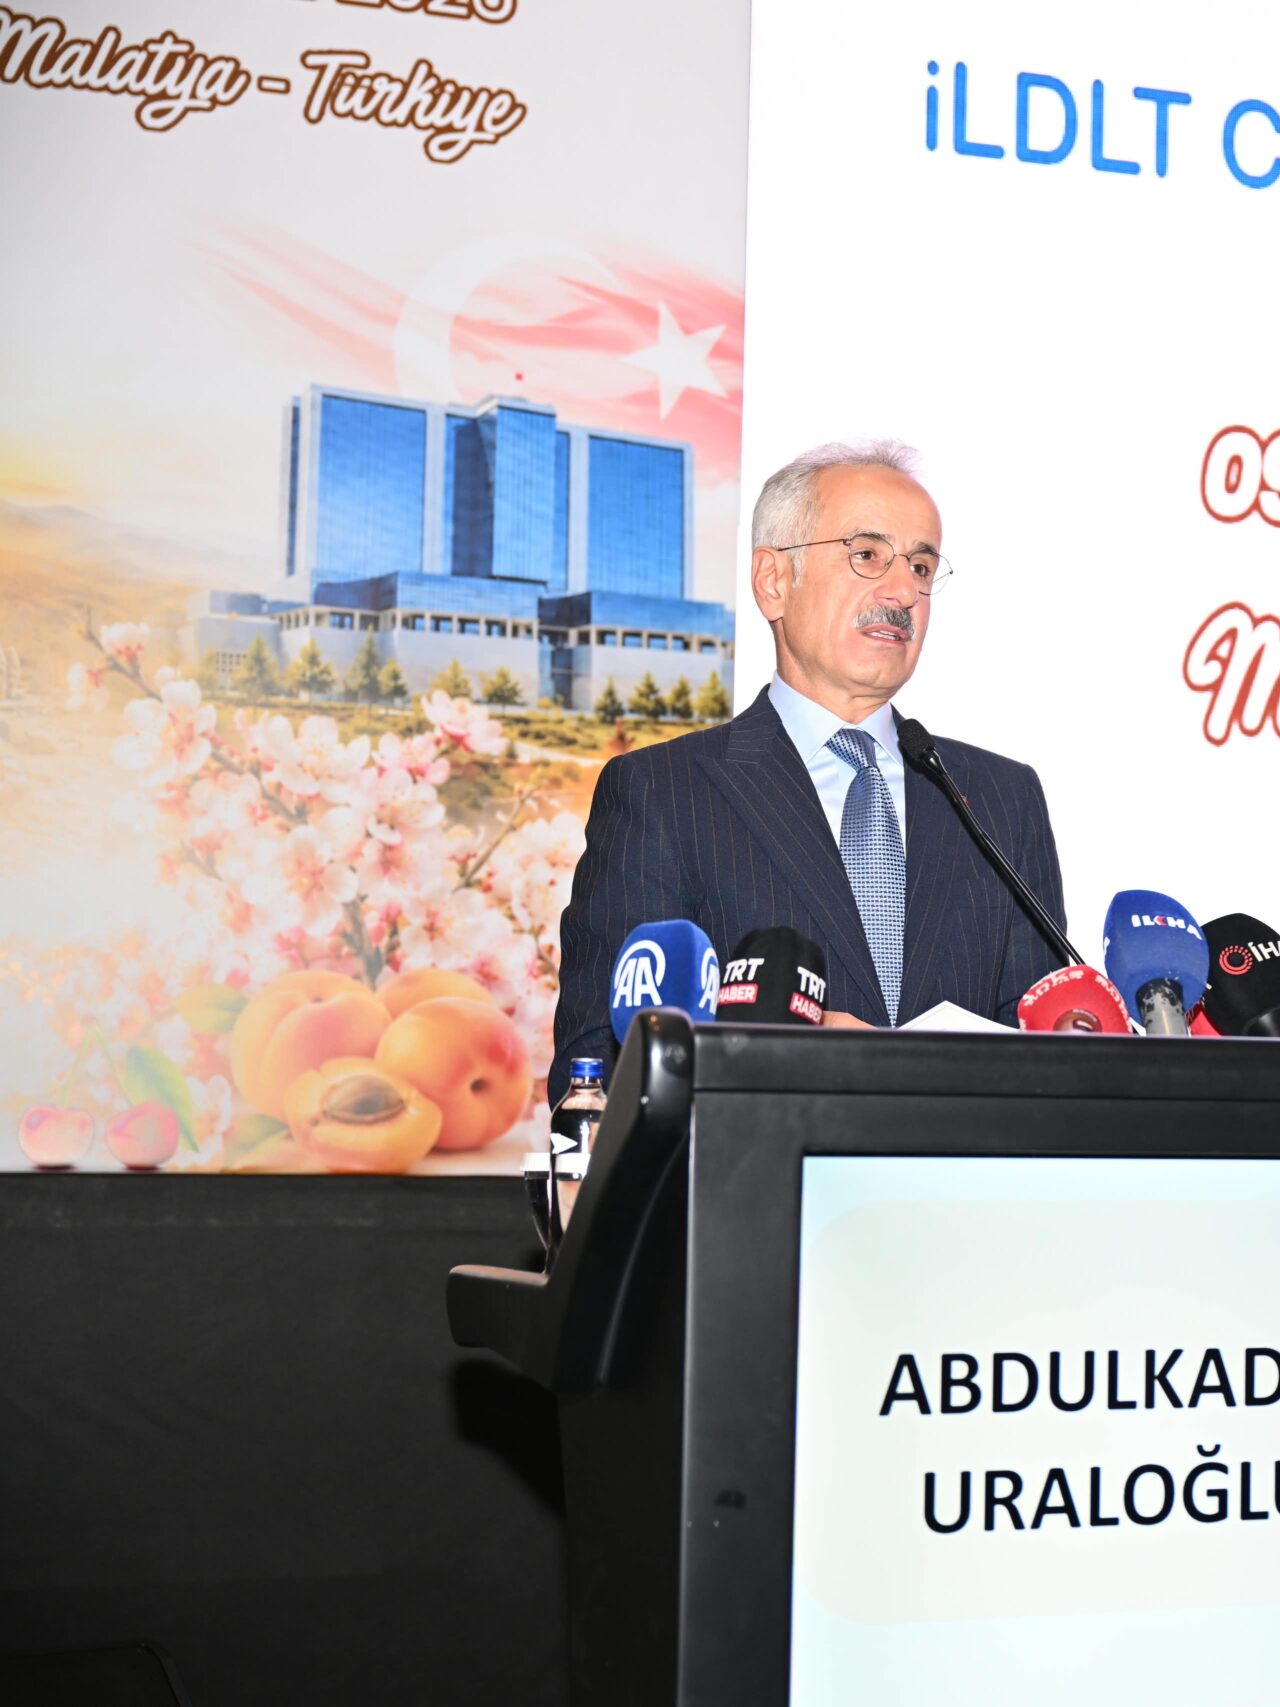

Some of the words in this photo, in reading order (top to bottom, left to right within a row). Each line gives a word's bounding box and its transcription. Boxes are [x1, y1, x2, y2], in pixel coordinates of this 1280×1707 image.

[0, 5, 252, 133] Malatya
[300, 48, 529, 165] Türkiye
[723, 957, 765, 985] TRT
[797, 965, 827, 1004] TRT
